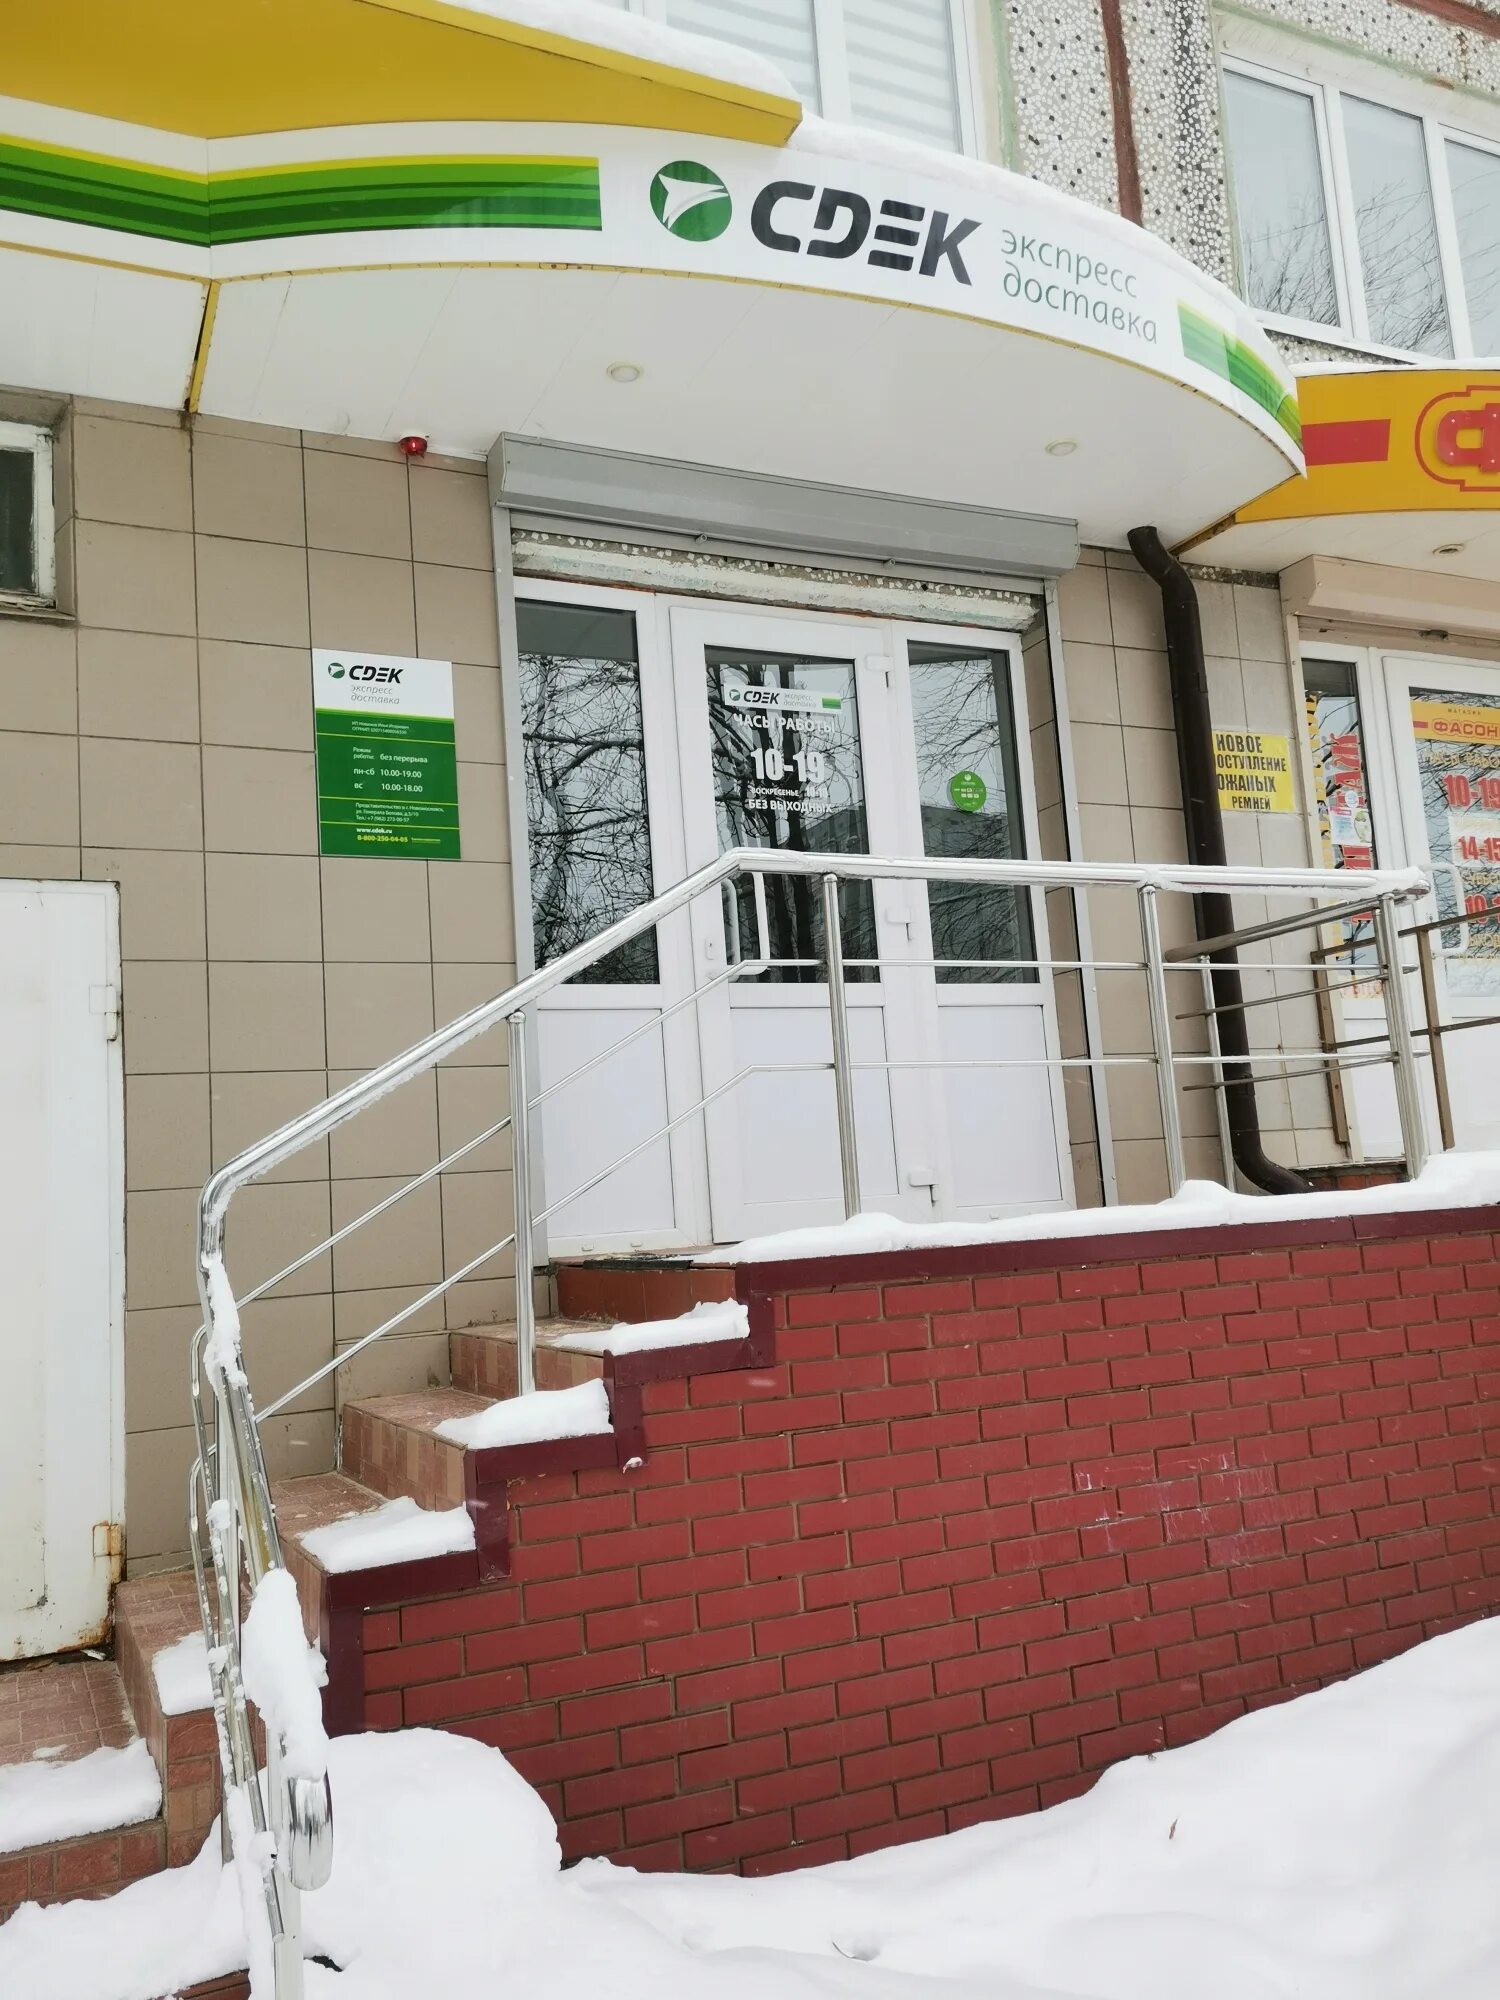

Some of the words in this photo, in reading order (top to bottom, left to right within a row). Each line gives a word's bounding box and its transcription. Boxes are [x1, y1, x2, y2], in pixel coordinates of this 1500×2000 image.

[750, 180, 983, 287] CDEK
[1001, 229, 1137, 298] экспресс
[1003, 260, 1158, 344] доставка
[349, 665, 404, 684] CDEK
[351, 685, 393, 695] экспресс
[743, 690, 780, 705] CDEK
[351, 692, 400, 705] доставка
[1433, 721, 1498, 738] ФАСОН
[1216, 733, 1263, 754] НОВОЕ
[380, 753, 393, 761] без
[393, 755, 428, 763] перерыва
[751, 748, 825, 783] 10-19
[353, 768, 375, 776] пн-сб
[380, 769, 422, 779] 10.00-19.00
[354, 782, 363, 790] вс
[381, 783, 423, 793] 10.00-18.00
[748, 798, 768, 810] БЕЗ
[769, 799, 833, 814] ВЫХОДНЫХ
[1231, 796, 1271, 810] РЕМНЕЙ
